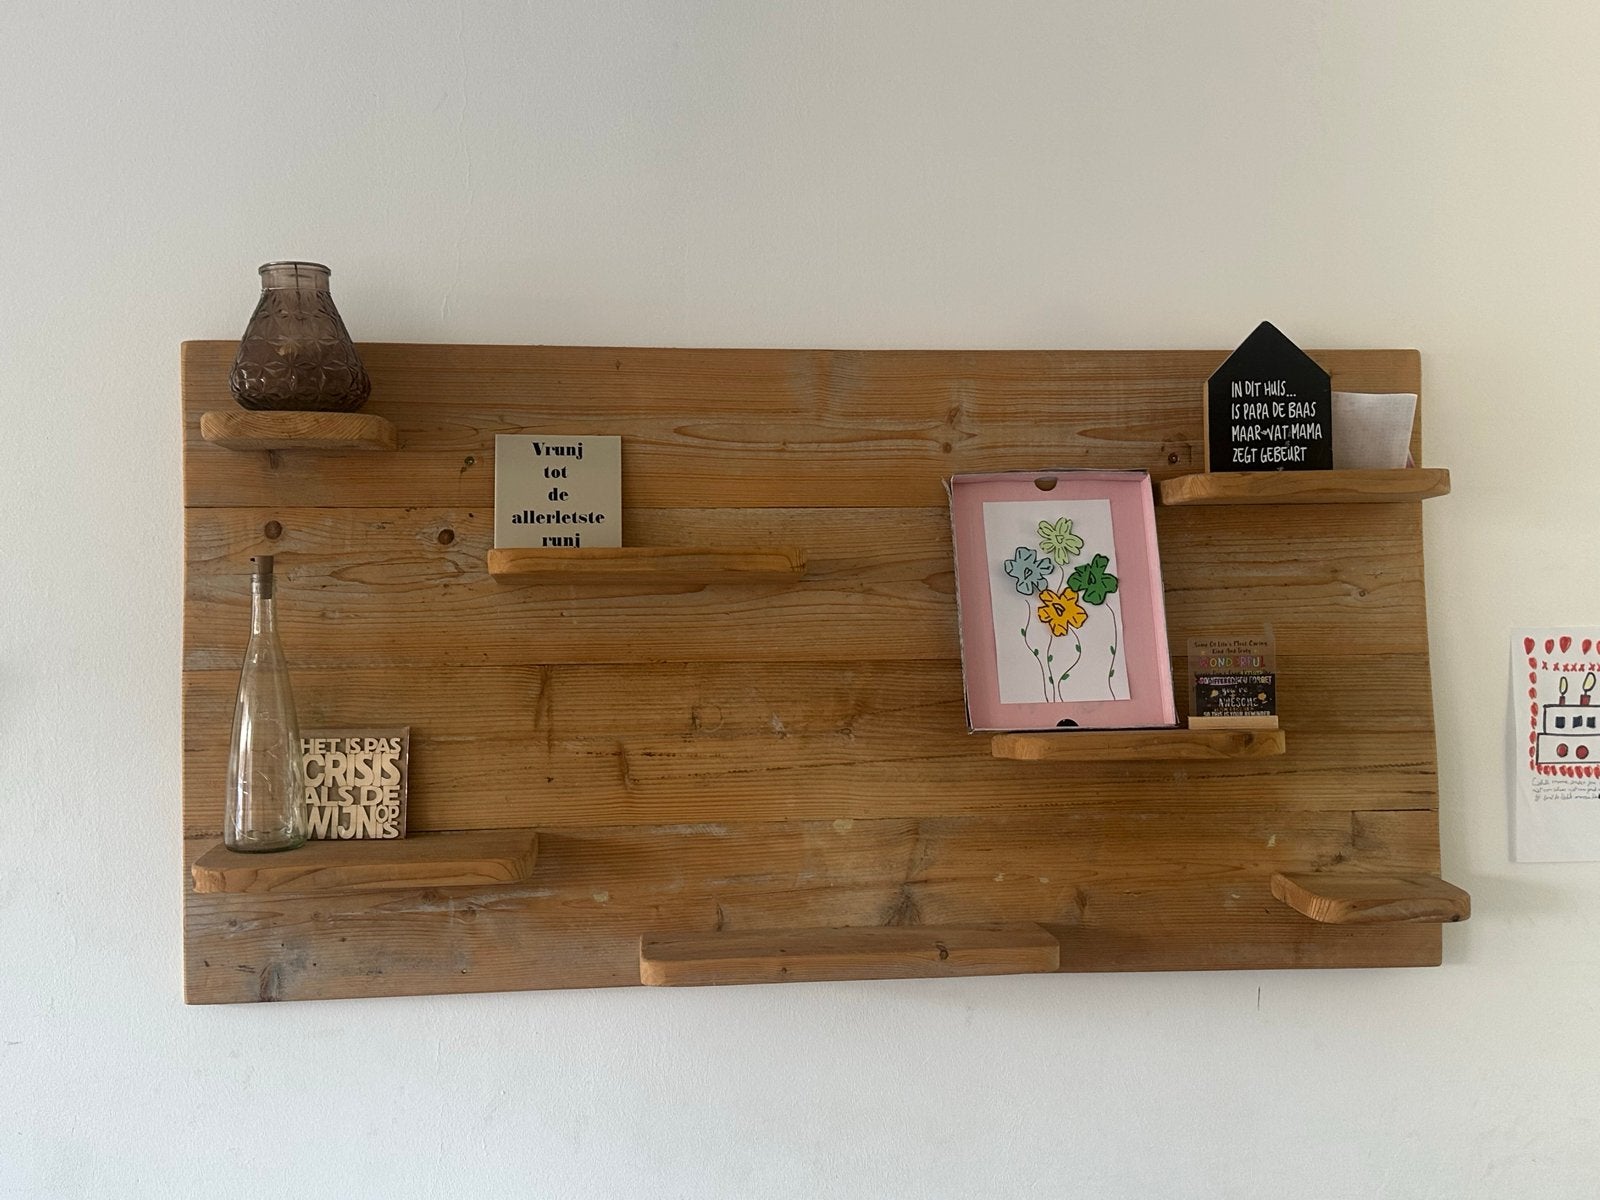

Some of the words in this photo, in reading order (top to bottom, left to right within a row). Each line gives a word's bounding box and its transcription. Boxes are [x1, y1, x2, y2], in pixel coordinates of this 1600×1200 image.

[1231, 380, 1243, 398] IN
[1245, 380, 1261, 397] DIT
[1231, 402, 1240, 420] IS
[1243, 402, 1269, 420] PAPA
[1272, 401, 1286, 418] DE
[1288, 401, 1317, 418] BAAS
[1231, 424, 1261, 442] MAAR
[1291, 422, 1323, 440] MAMA
[532, 441, 583, 460] Vrunj
[1232, 446, 1258, 463] ZEGT
[1260, 445, 1308, 463] GEBEURT
[544, 466, 568, 479] tot
[547, 487, 569, 502] de
[511, 510, 605, 525] allerletste
[542, 533, 580, 549] runj
[300, 738, 341, 755] HET
[346, 737, 361, 754] IS
[364, 737, 401, 754] PAS
[302, 751, 401, 788] CRISIS
[304, 785, 355, 807] ALS
[360, 785, 401, 806] DE
[305, 804, 377, 840] WIJN
[376, 804, 400, 823] OP
[377, 820, 400, 839] IS
